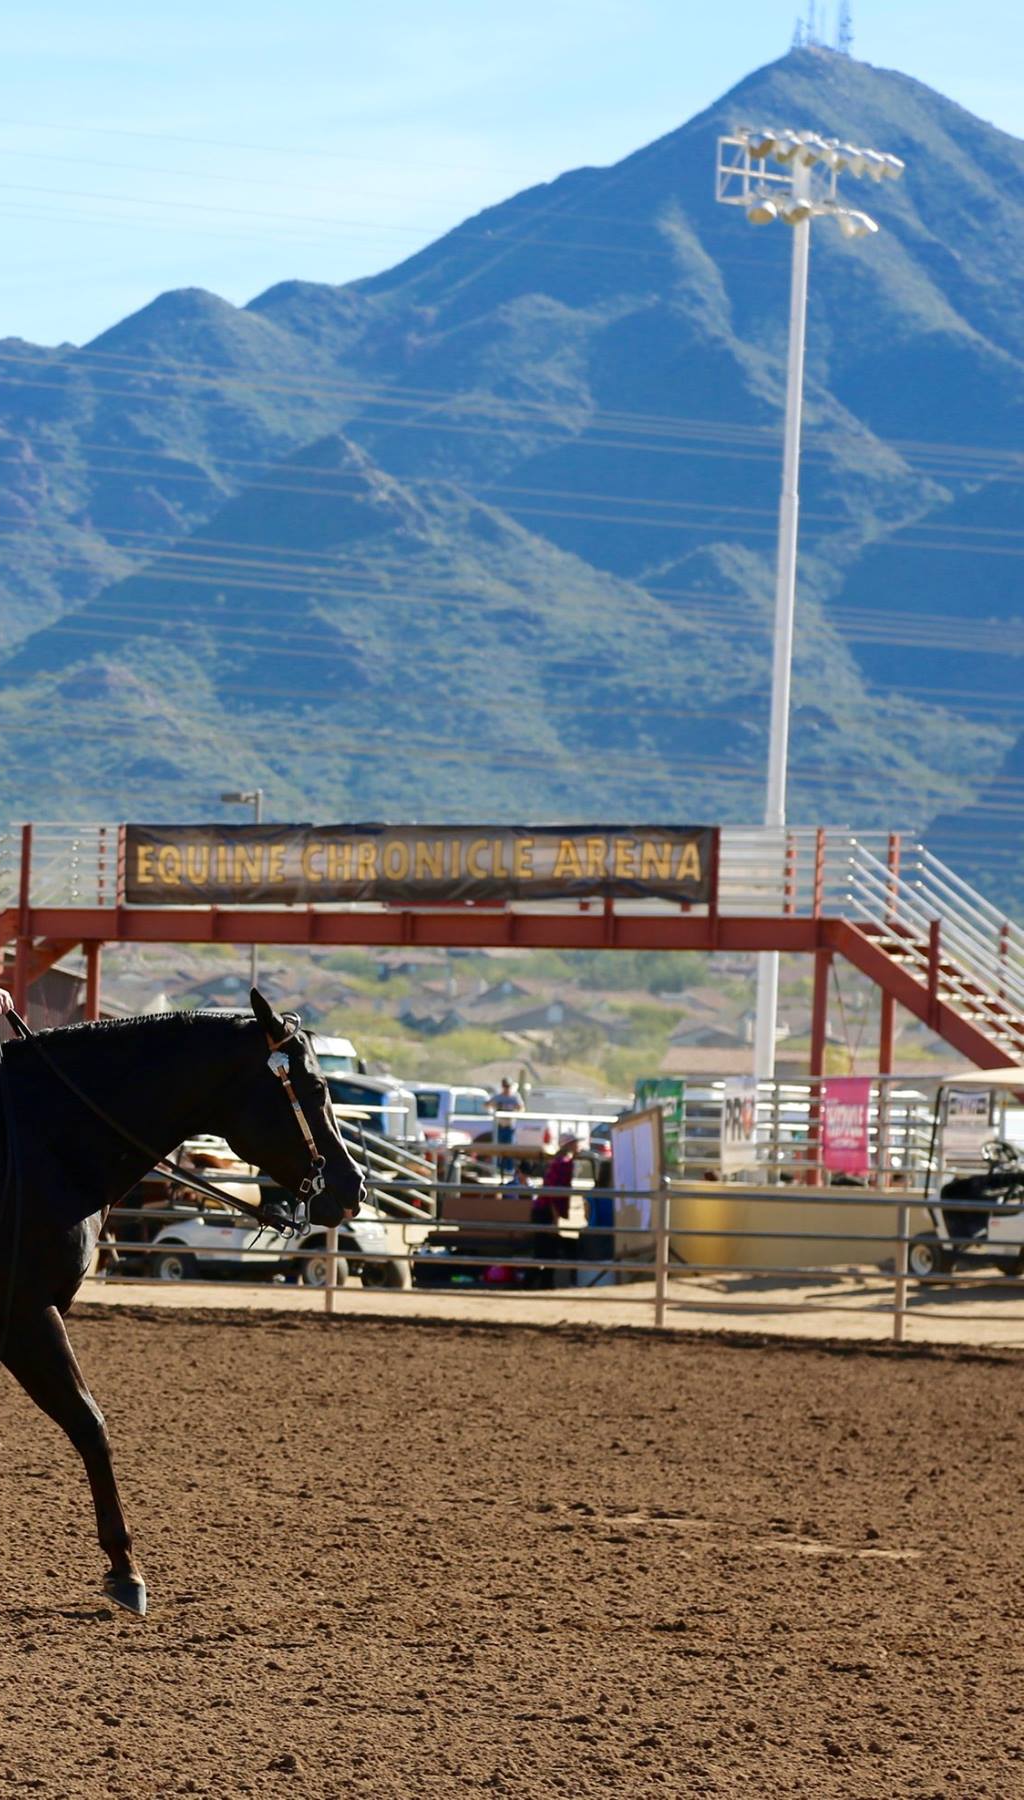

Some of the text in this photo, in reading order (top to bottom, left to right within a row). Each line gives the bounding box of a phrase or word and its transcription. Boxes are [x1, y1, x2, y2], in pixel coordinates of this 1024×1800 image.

[136, 838, 702, 885] EQUINE CHRONICLE ARENA
